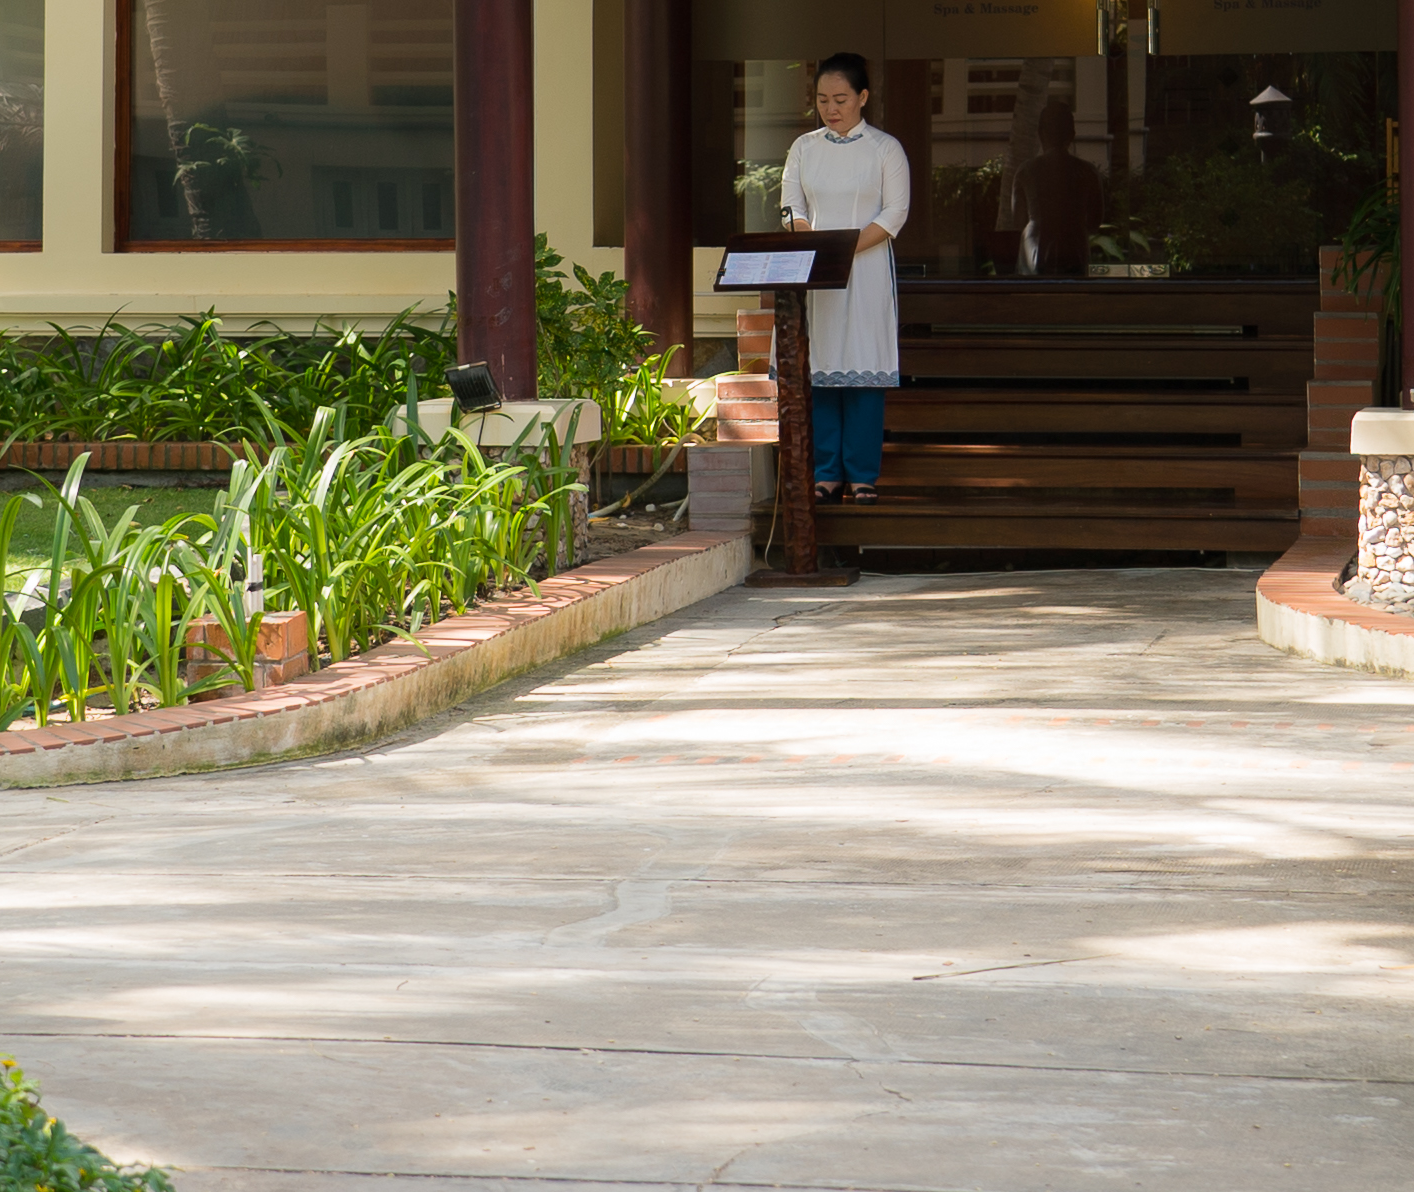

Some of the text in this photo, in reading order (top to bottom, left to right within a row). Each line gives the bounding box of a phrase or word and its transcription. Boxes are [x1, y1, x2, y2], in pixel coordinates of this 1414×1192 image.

[934, 3, 1039, 17] Spa & Massage
